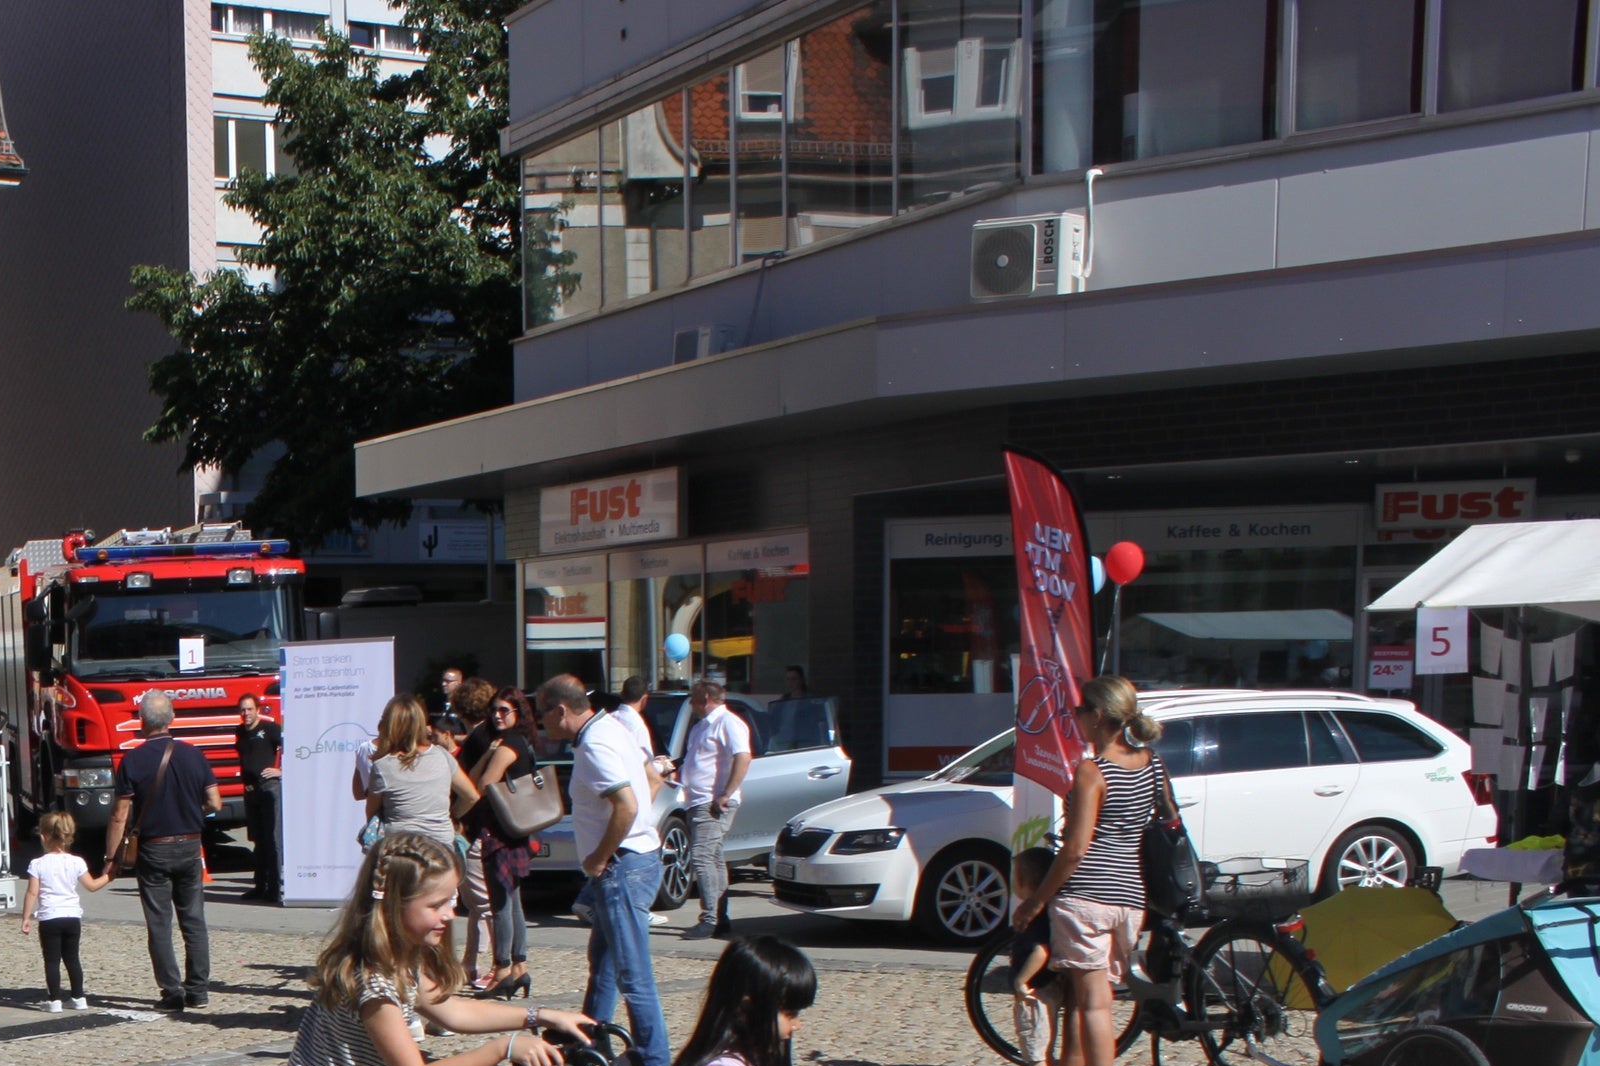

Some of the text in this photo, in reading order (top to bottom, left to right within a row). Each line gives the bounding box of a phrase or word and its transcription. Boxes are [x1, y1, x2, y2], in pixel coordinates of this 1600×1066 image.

[1042, 219, 1055, 265] BOSCH
[570, 479, 642, 526] Fust
[1382, 486, 1528, 523] Fust
[618, 520, 660, 537] Multimedia
[1166, 522, 1311, 539] Kaffee & Kochen
[924, 533, 1003, 548] Reinigung
[1430, 626, 1451, 656] 5
[188, 650, 197, 665] 1
[306, 667, 366, 679] Stadtzentrum
[163, 687, 227, 700] SCANIA
